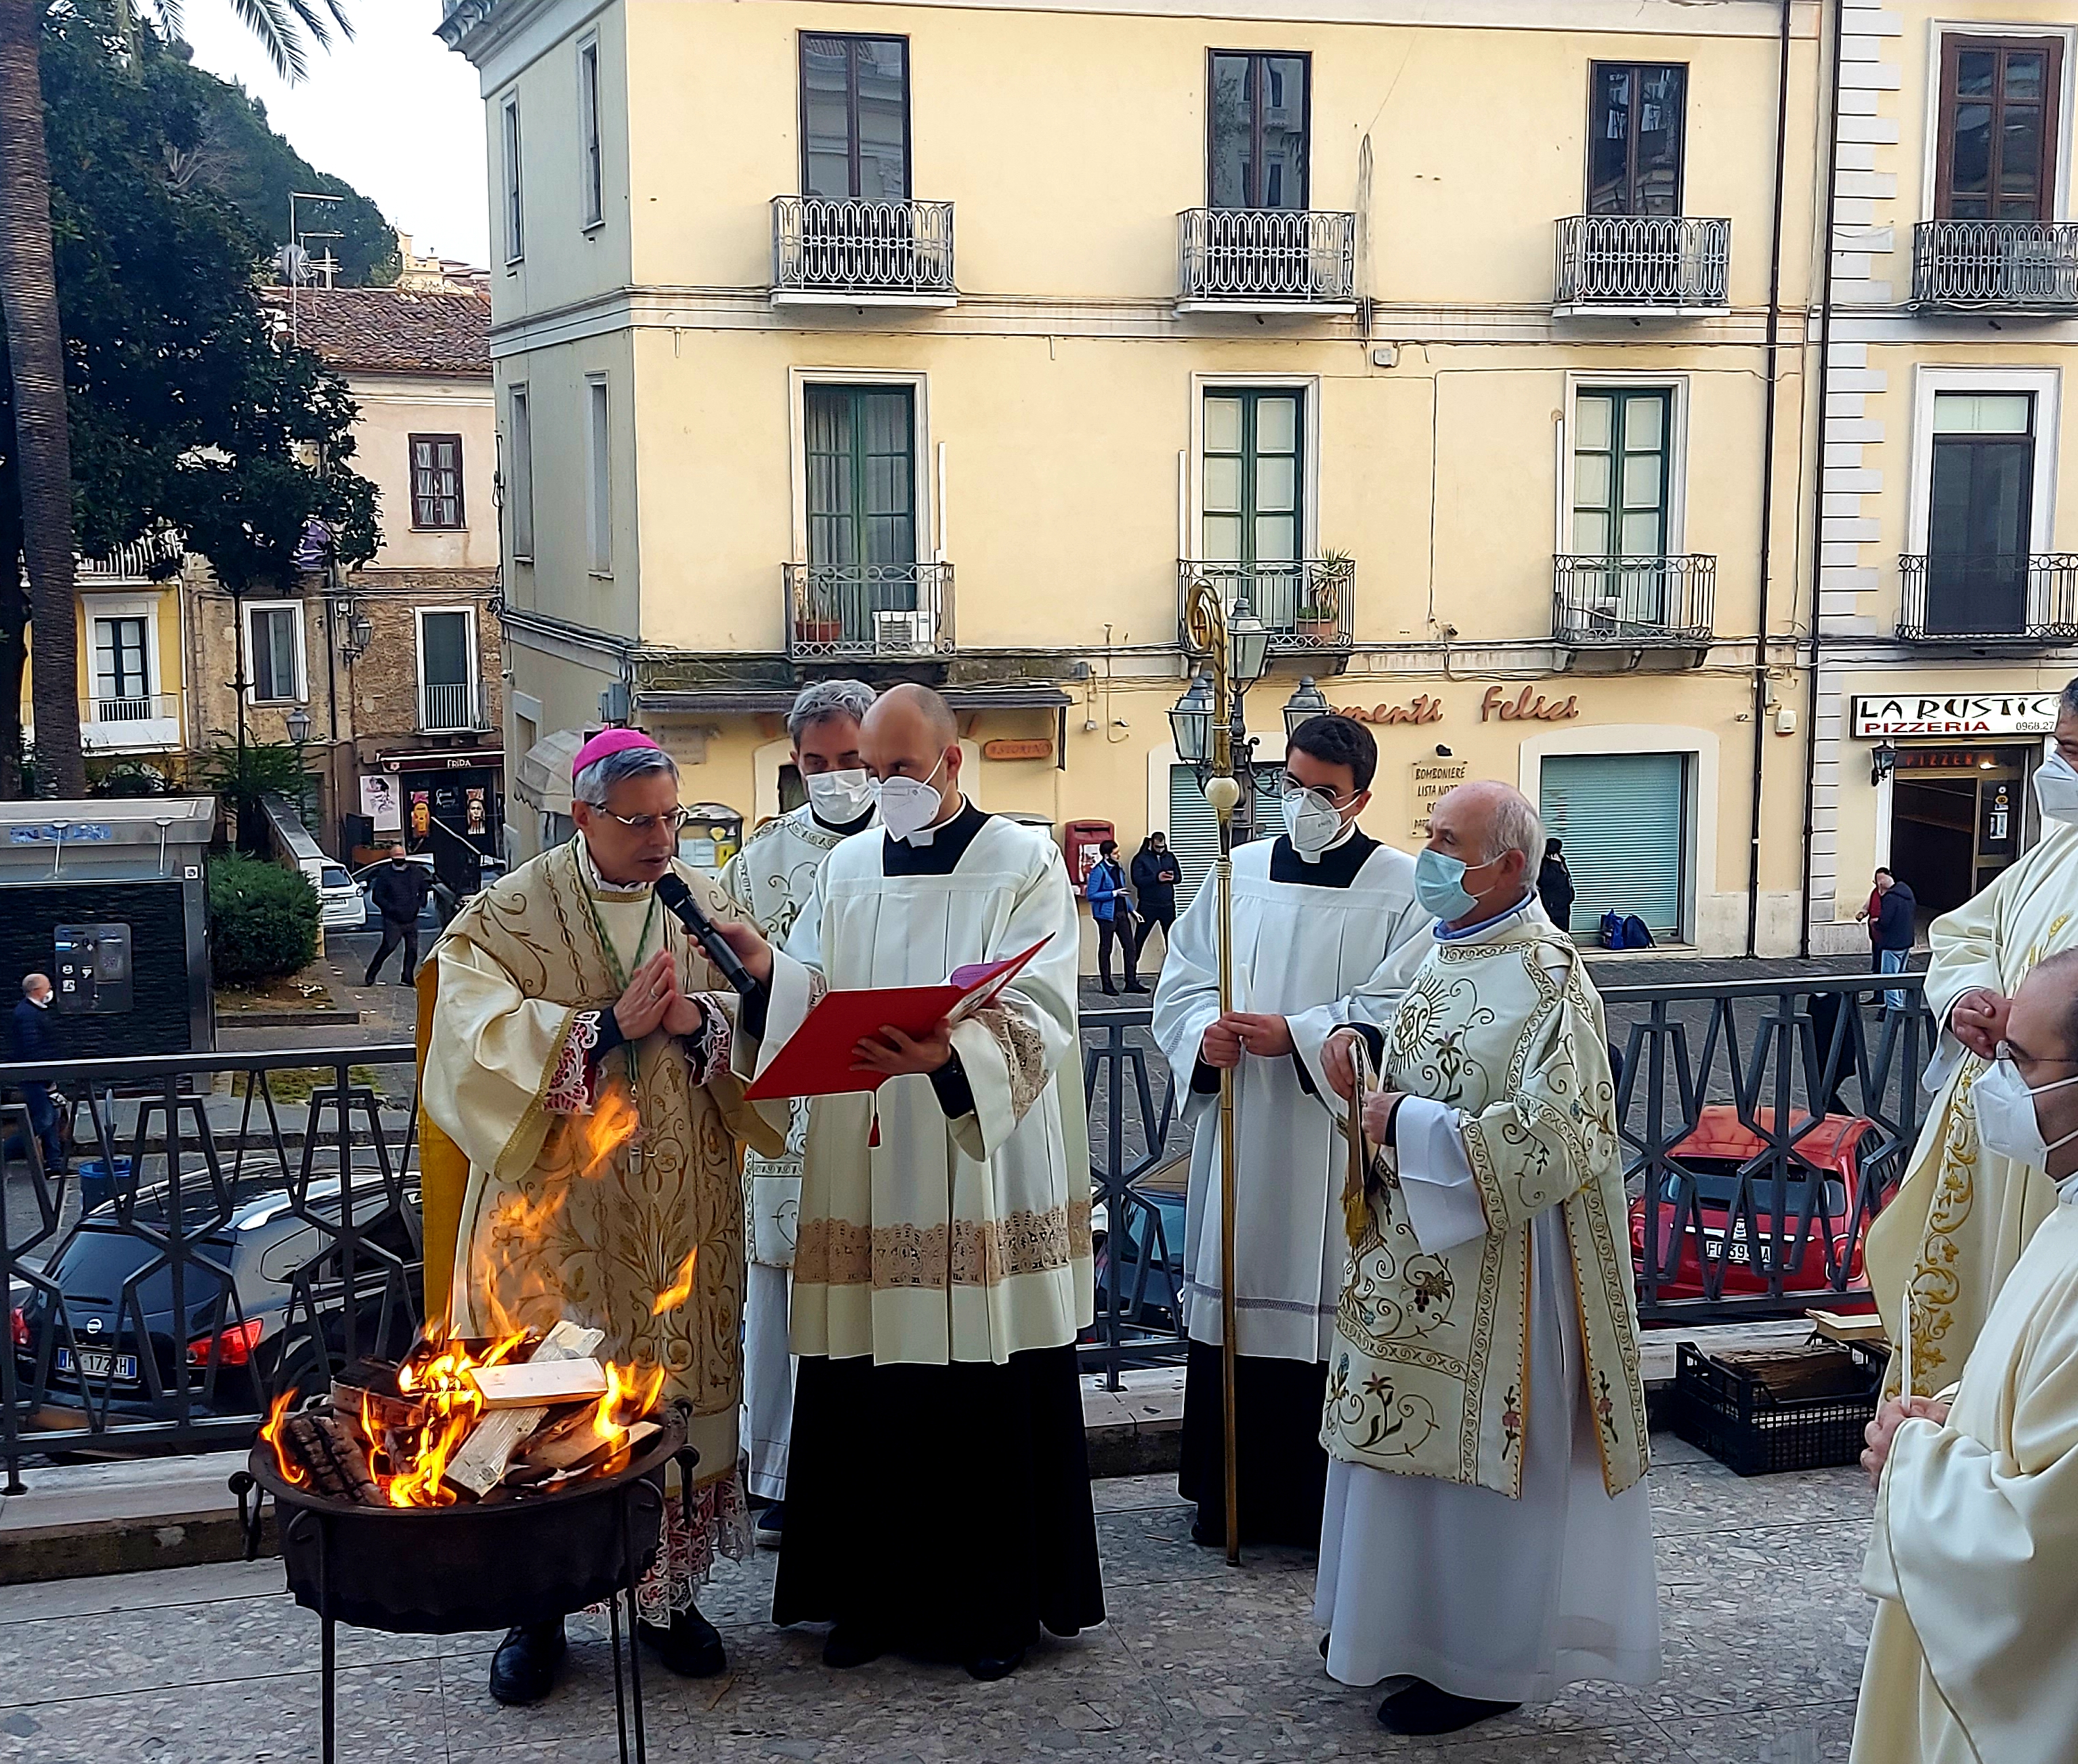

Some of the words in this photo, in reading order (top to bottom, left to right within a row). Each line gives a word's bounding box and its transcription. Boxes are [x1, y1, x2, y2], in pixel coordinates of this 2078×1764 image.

[1481, 686, 1579, 722] Felici
[1860, 700, 1903, 719] LA
[1865, 721, 1990, 733] PIZZERIA
[447, 759, 471, 768] FRIDA
[1416, 767, 1466, 780] BOMBONIERE
[1418, 785, 1436, 797] LISTA
